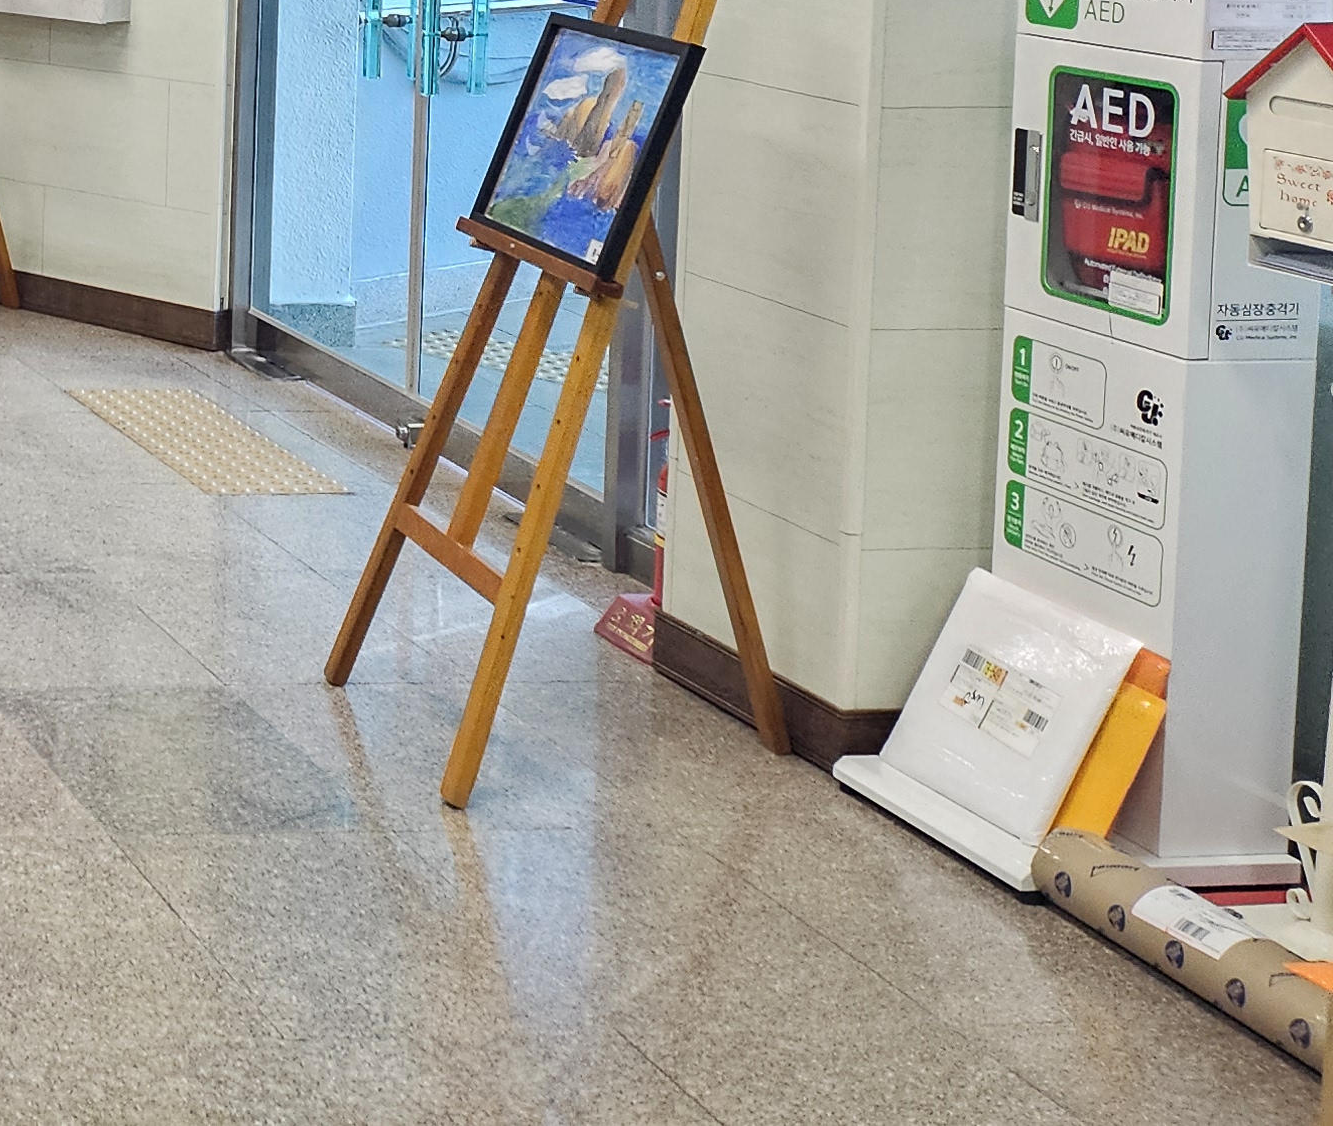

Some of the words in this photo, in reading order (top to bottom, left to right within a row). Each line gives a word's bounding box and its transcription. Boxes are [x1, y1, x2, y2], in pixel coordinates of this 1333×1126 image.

[1084, 0, 1125, 24] AED
[1070, 84, 1155, 138] AED
[1095, 134, 1117, 149] 일반인
[1118, 139, 1134, 153] 사용
[1135, 142, 1150, 157] 가능
[1277, 173, 1321, 192] Sweet
[1280, 189, 1317, 207] home
[1107, 226, 1150, 254] IPAD
[1217, 302, 1299, 317] 자동심장충격기
[1019, 347, 1026, 366] 1
[1014, 419, 1024, 439] 2
[1010, 491, 1020, 510] 3
